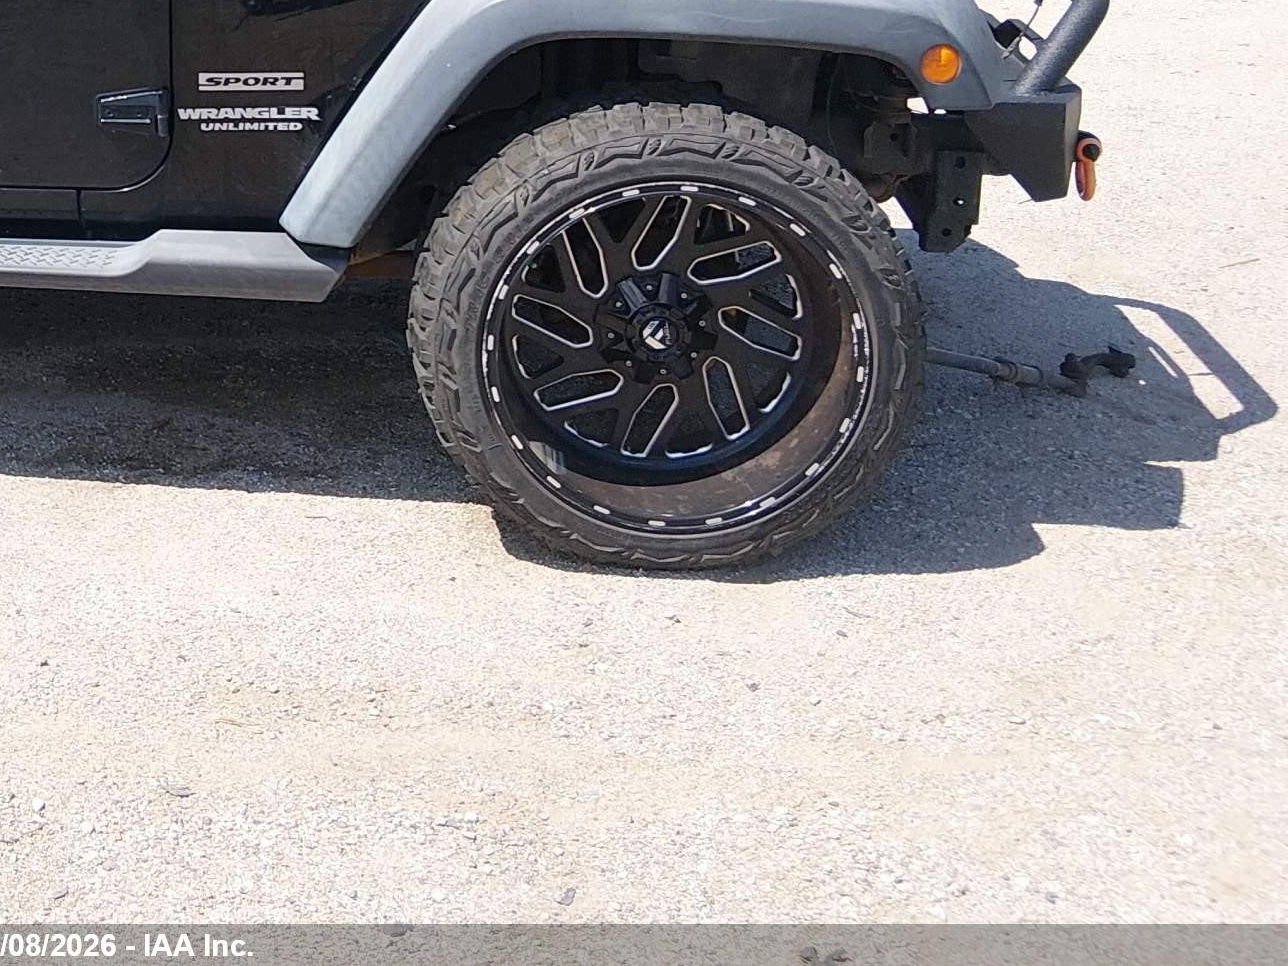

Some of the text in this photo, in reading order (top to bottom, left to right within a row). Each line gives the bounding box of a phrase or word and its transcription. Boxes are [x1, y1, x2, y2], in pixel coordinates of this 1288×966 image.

[202, 75, 304, 88] SPORT
[177, 107, 321, 120] WRANGLER
[200, 122, 303, 131] UNLIMITED
